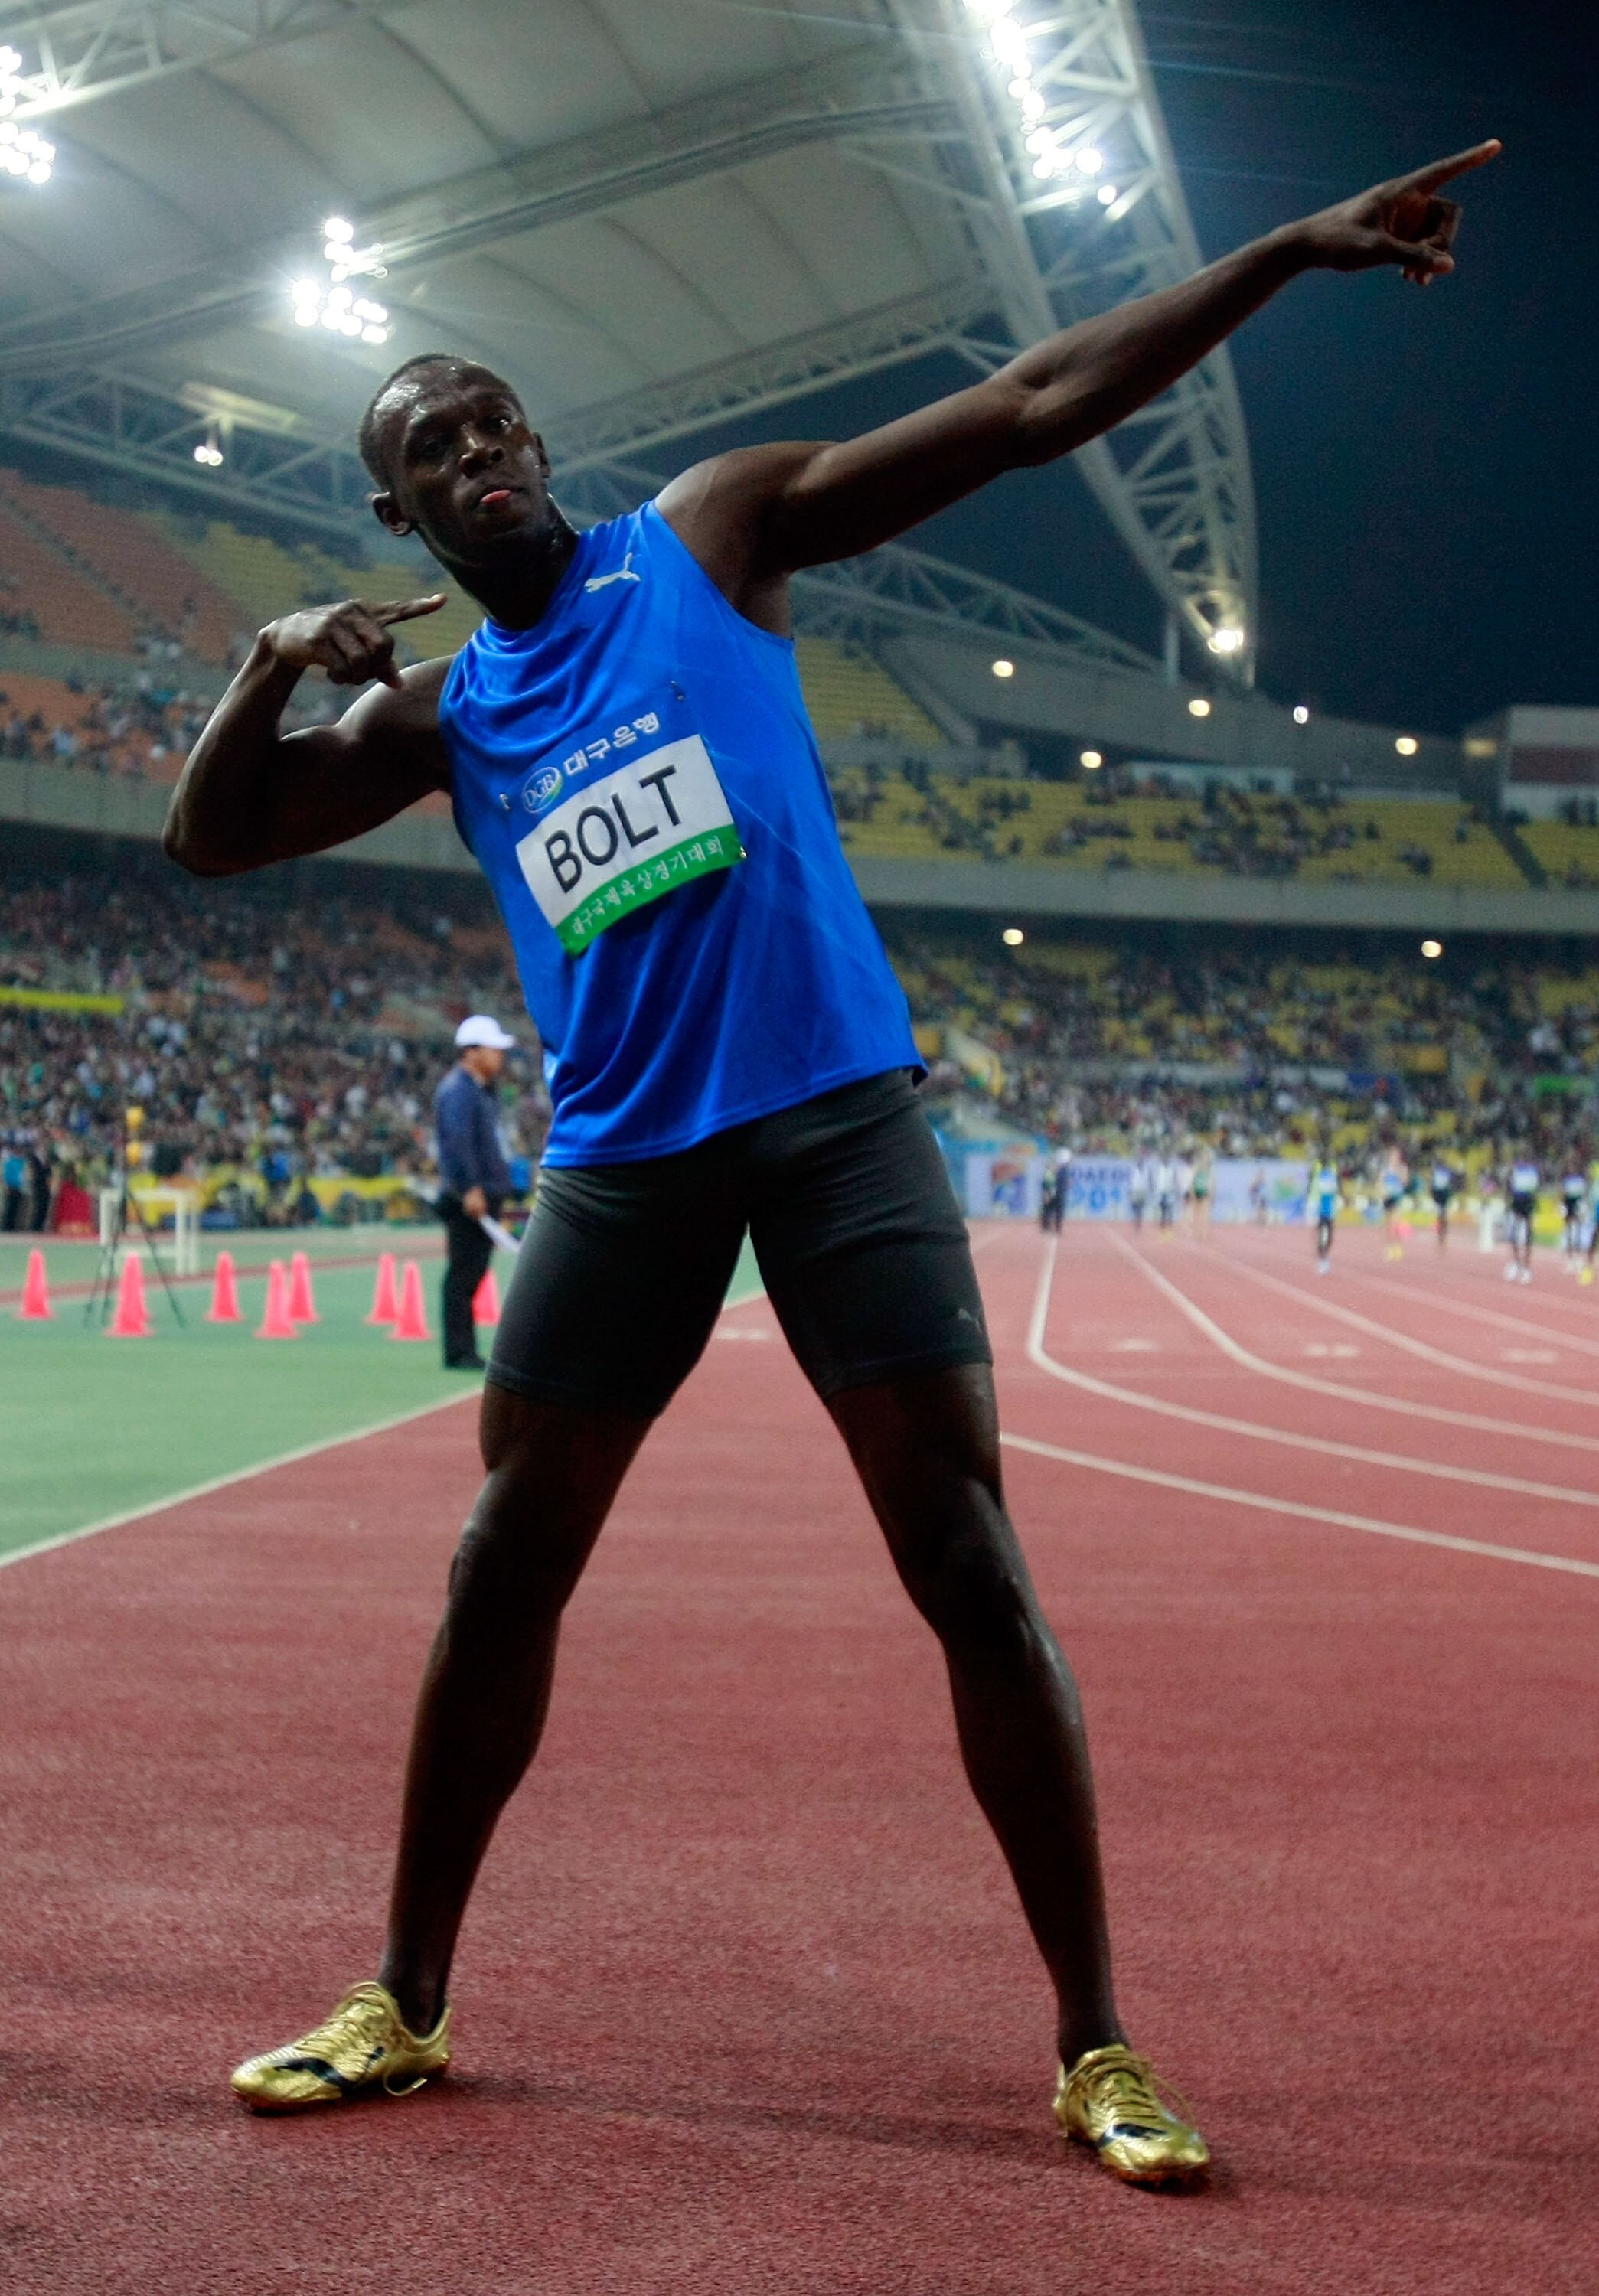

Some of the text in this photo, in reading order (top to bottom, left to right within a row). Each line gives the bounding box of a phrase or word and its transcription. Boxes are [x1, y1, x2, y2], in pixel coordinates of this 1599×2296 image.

[563, 711, 660, 776] 대구은행
[526, 773, 555, 807] DGB
[544, 764, 681, 894] BOLT
